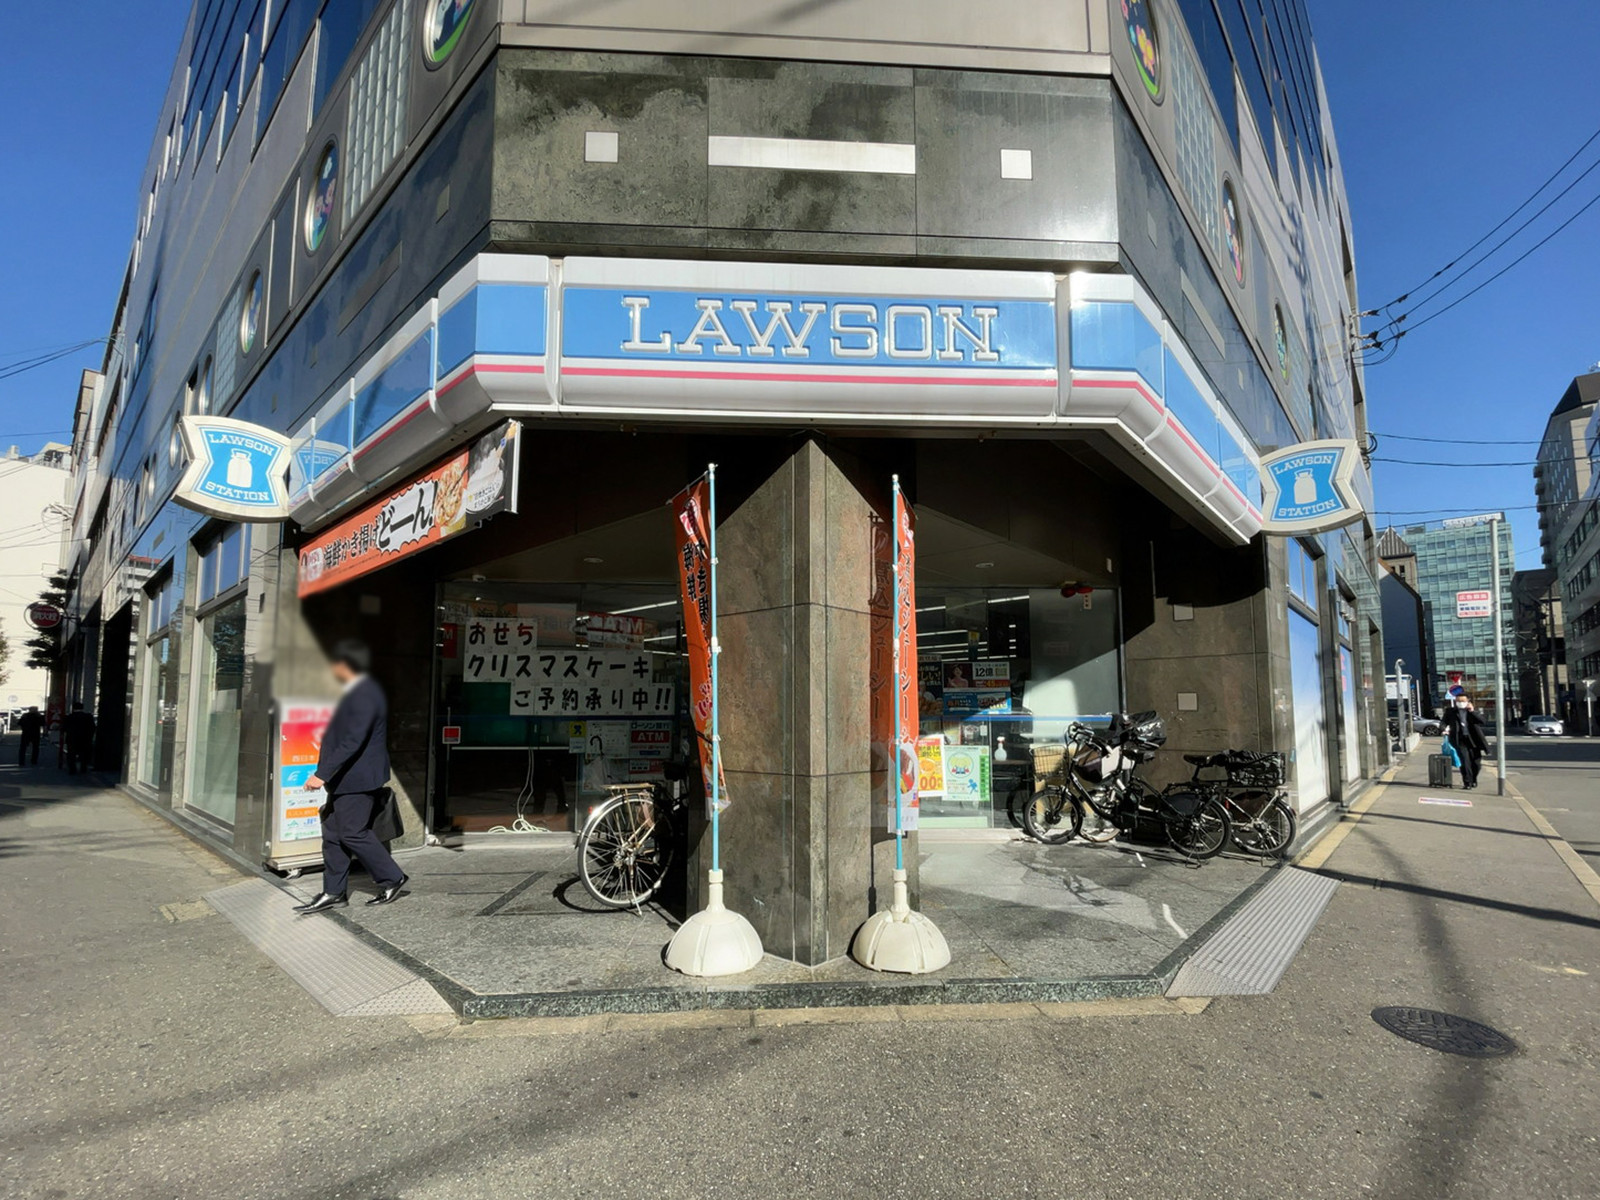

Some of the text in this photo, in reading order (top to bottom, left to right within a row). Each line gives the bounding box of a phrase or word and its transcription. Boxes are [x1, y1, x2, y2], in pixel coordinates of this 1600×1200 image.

[620, 295, 1000, 362] LAWSON
[208, 433, 275, 457] LAWSON
[1273, 455, 1334, 475] LAWSON
[204, 482, 271, 501] STATION
[1278, 499, 1337, 517] STATION
[468, 622, 534, 646] おせち
[468, 655, 649, 678] クリスマスケーキ
[514, 688, 671, 711] ご予約承り中!!
[637, 732, 664, 741] ATM
